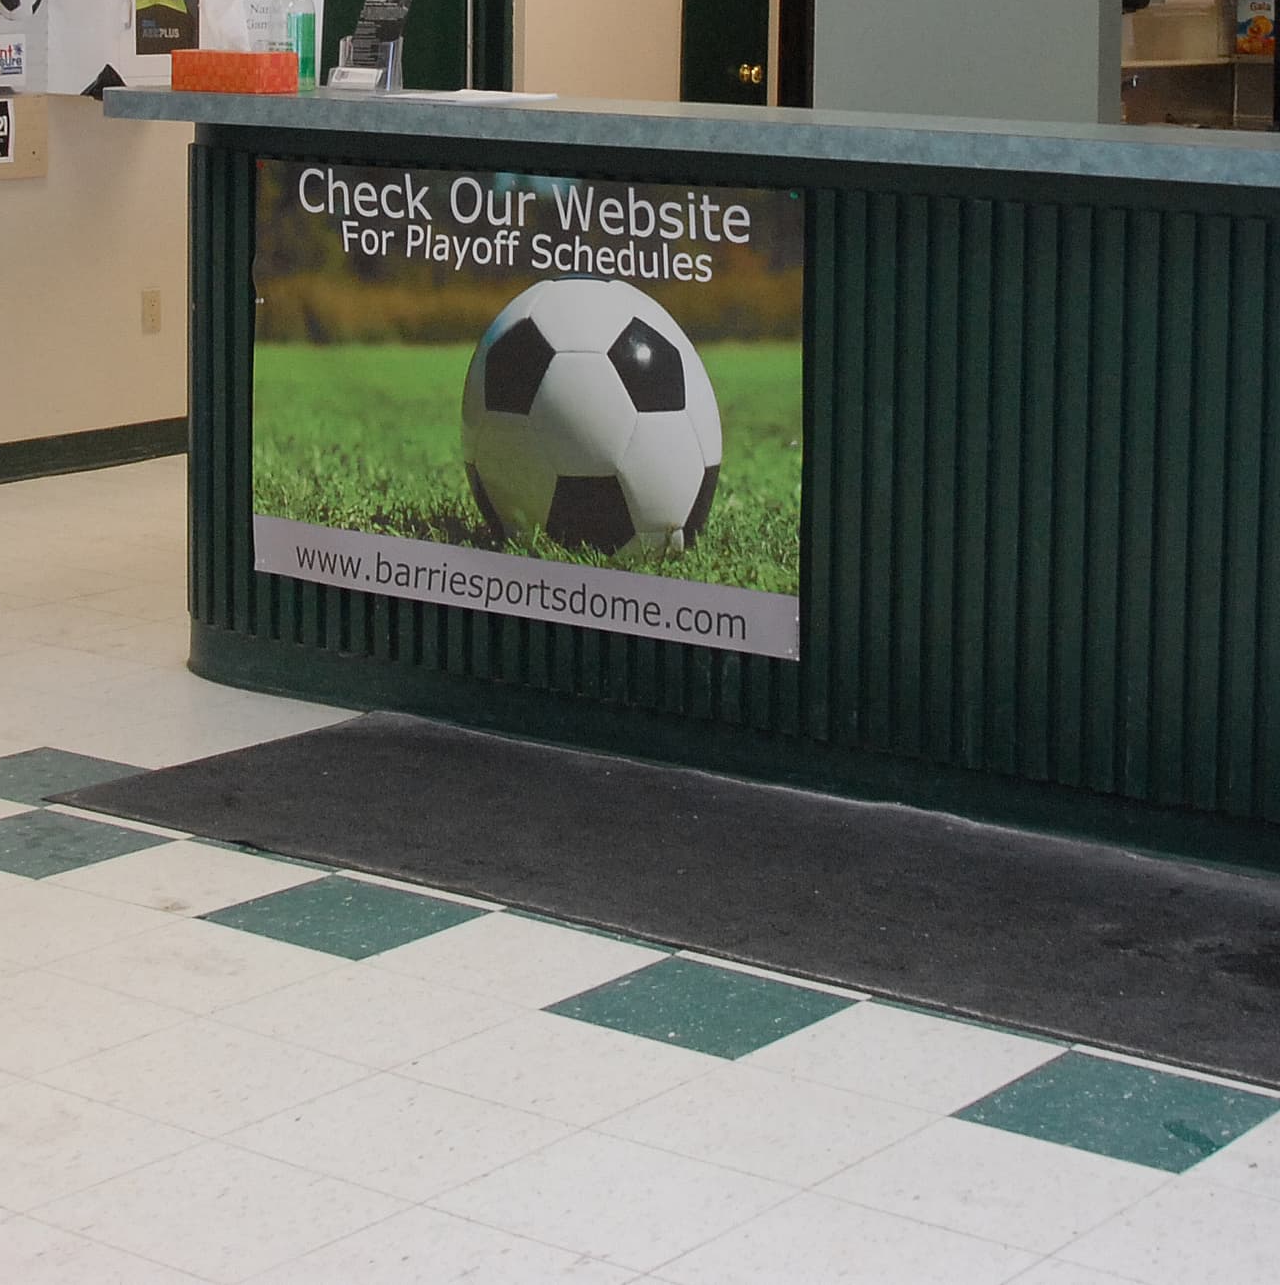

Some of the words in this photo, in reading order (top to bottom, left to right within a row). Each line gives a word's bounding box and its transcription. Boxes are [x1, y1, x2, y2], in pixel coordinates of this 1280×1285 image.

[299, 168, 433, 222] Check
[450, 177, 536, 227] Our
[554, 185, 751, 244] Website
[342, 221, 394, 255] For
[406, 226, 520, 271] Playoff
[531, 234, 713, 283] Schedules
[296, 542, 747, 640] www.barriesportsdome.com
